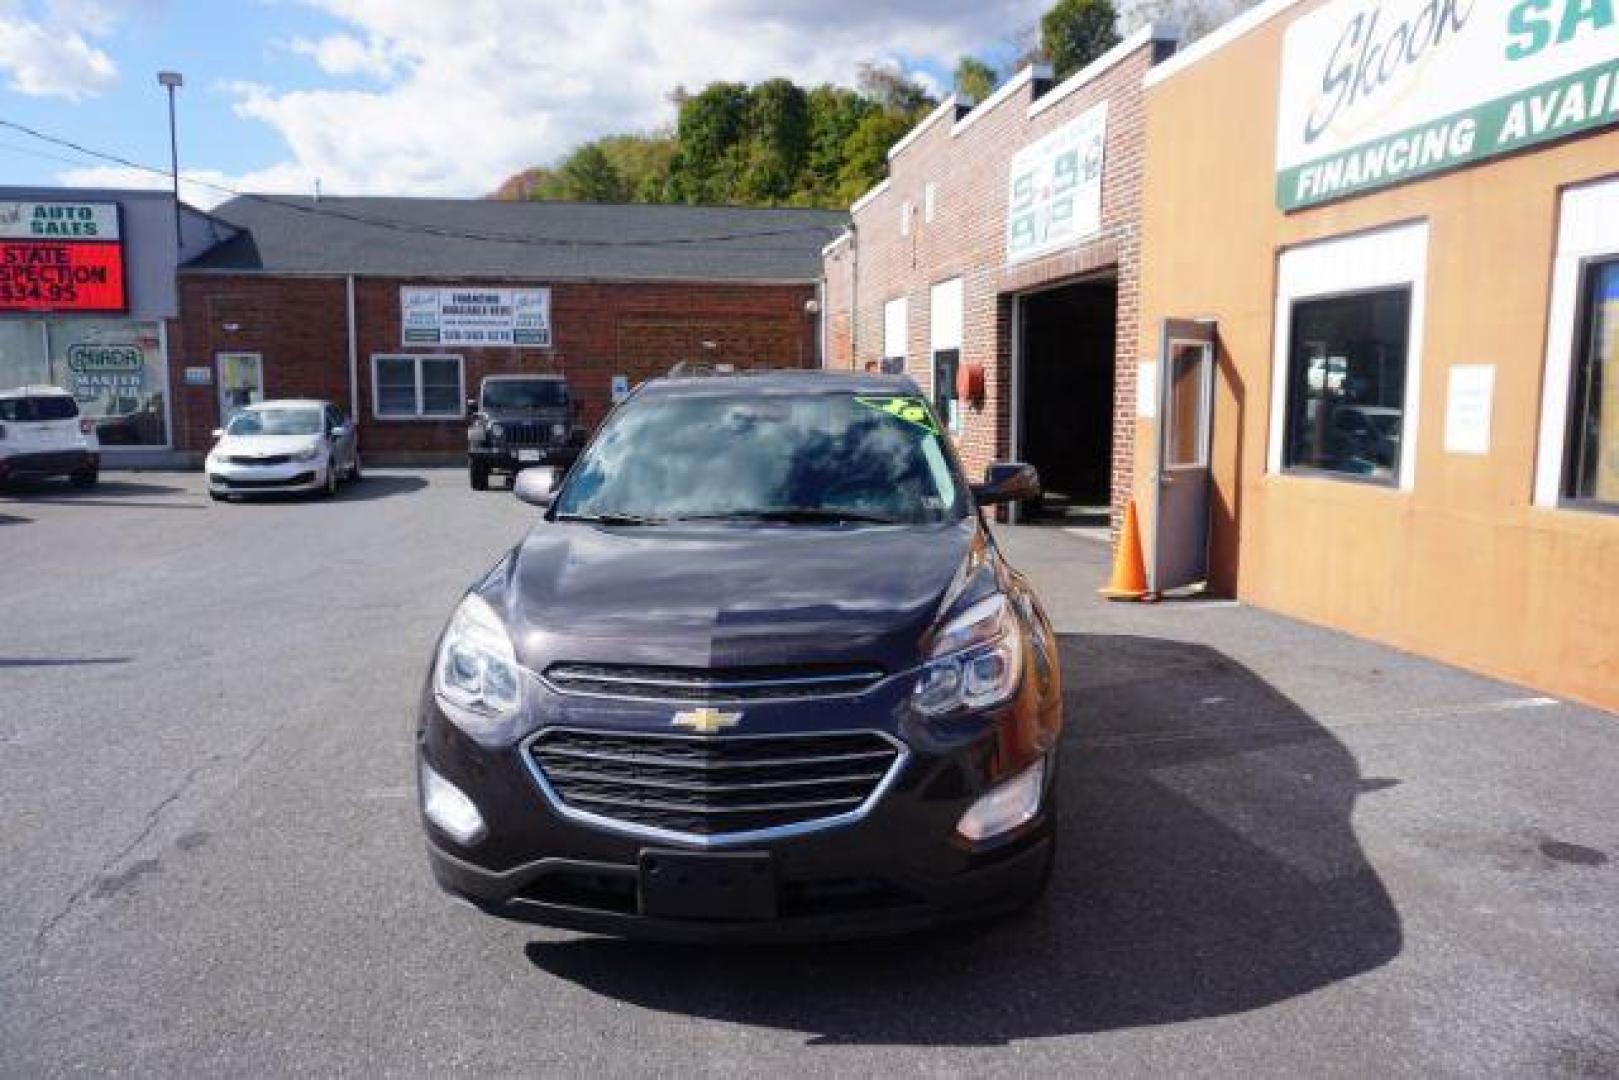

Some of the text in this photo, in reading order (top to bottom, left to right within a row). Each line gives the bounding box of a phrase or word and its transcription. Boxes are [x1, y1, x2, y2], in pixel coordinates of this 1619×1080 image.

[1297, 118, 1477, 201] FINANCING
[33, 206, 92, 220] AUTO
[30, 220, 97, 235] SALES
[4, 247, 68, 264] STATE
